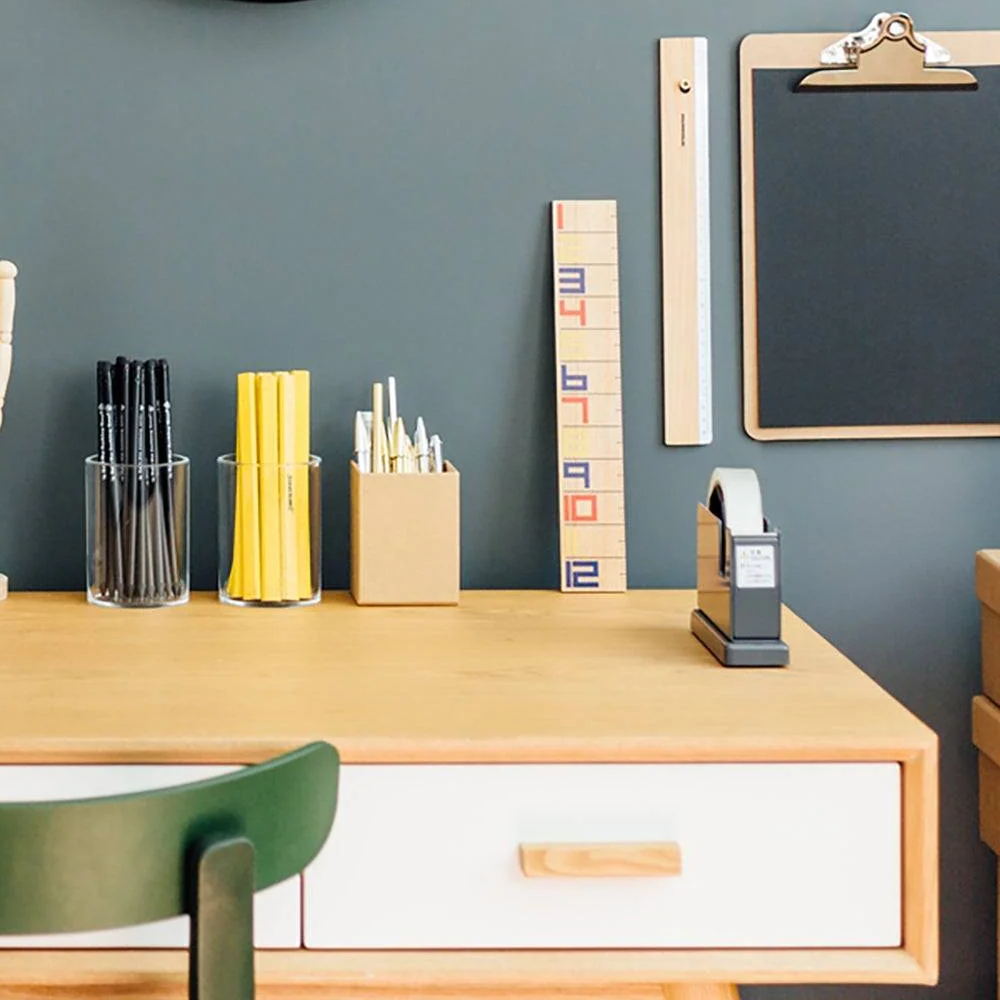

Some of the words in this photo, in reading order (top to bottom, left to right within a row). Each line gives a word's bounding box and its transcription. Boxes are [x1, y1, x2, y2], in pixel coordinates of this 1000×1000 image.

[559, 267, 586, 294] 3
[559, 299, 586, 326] 4
[561, 365, 588, 391] 6
[562, 397, 588, 424] 7
[563, 462, 590, 488] 9
[563, 495, 597, 522] 10
[565, 560, 599, 588] 12
